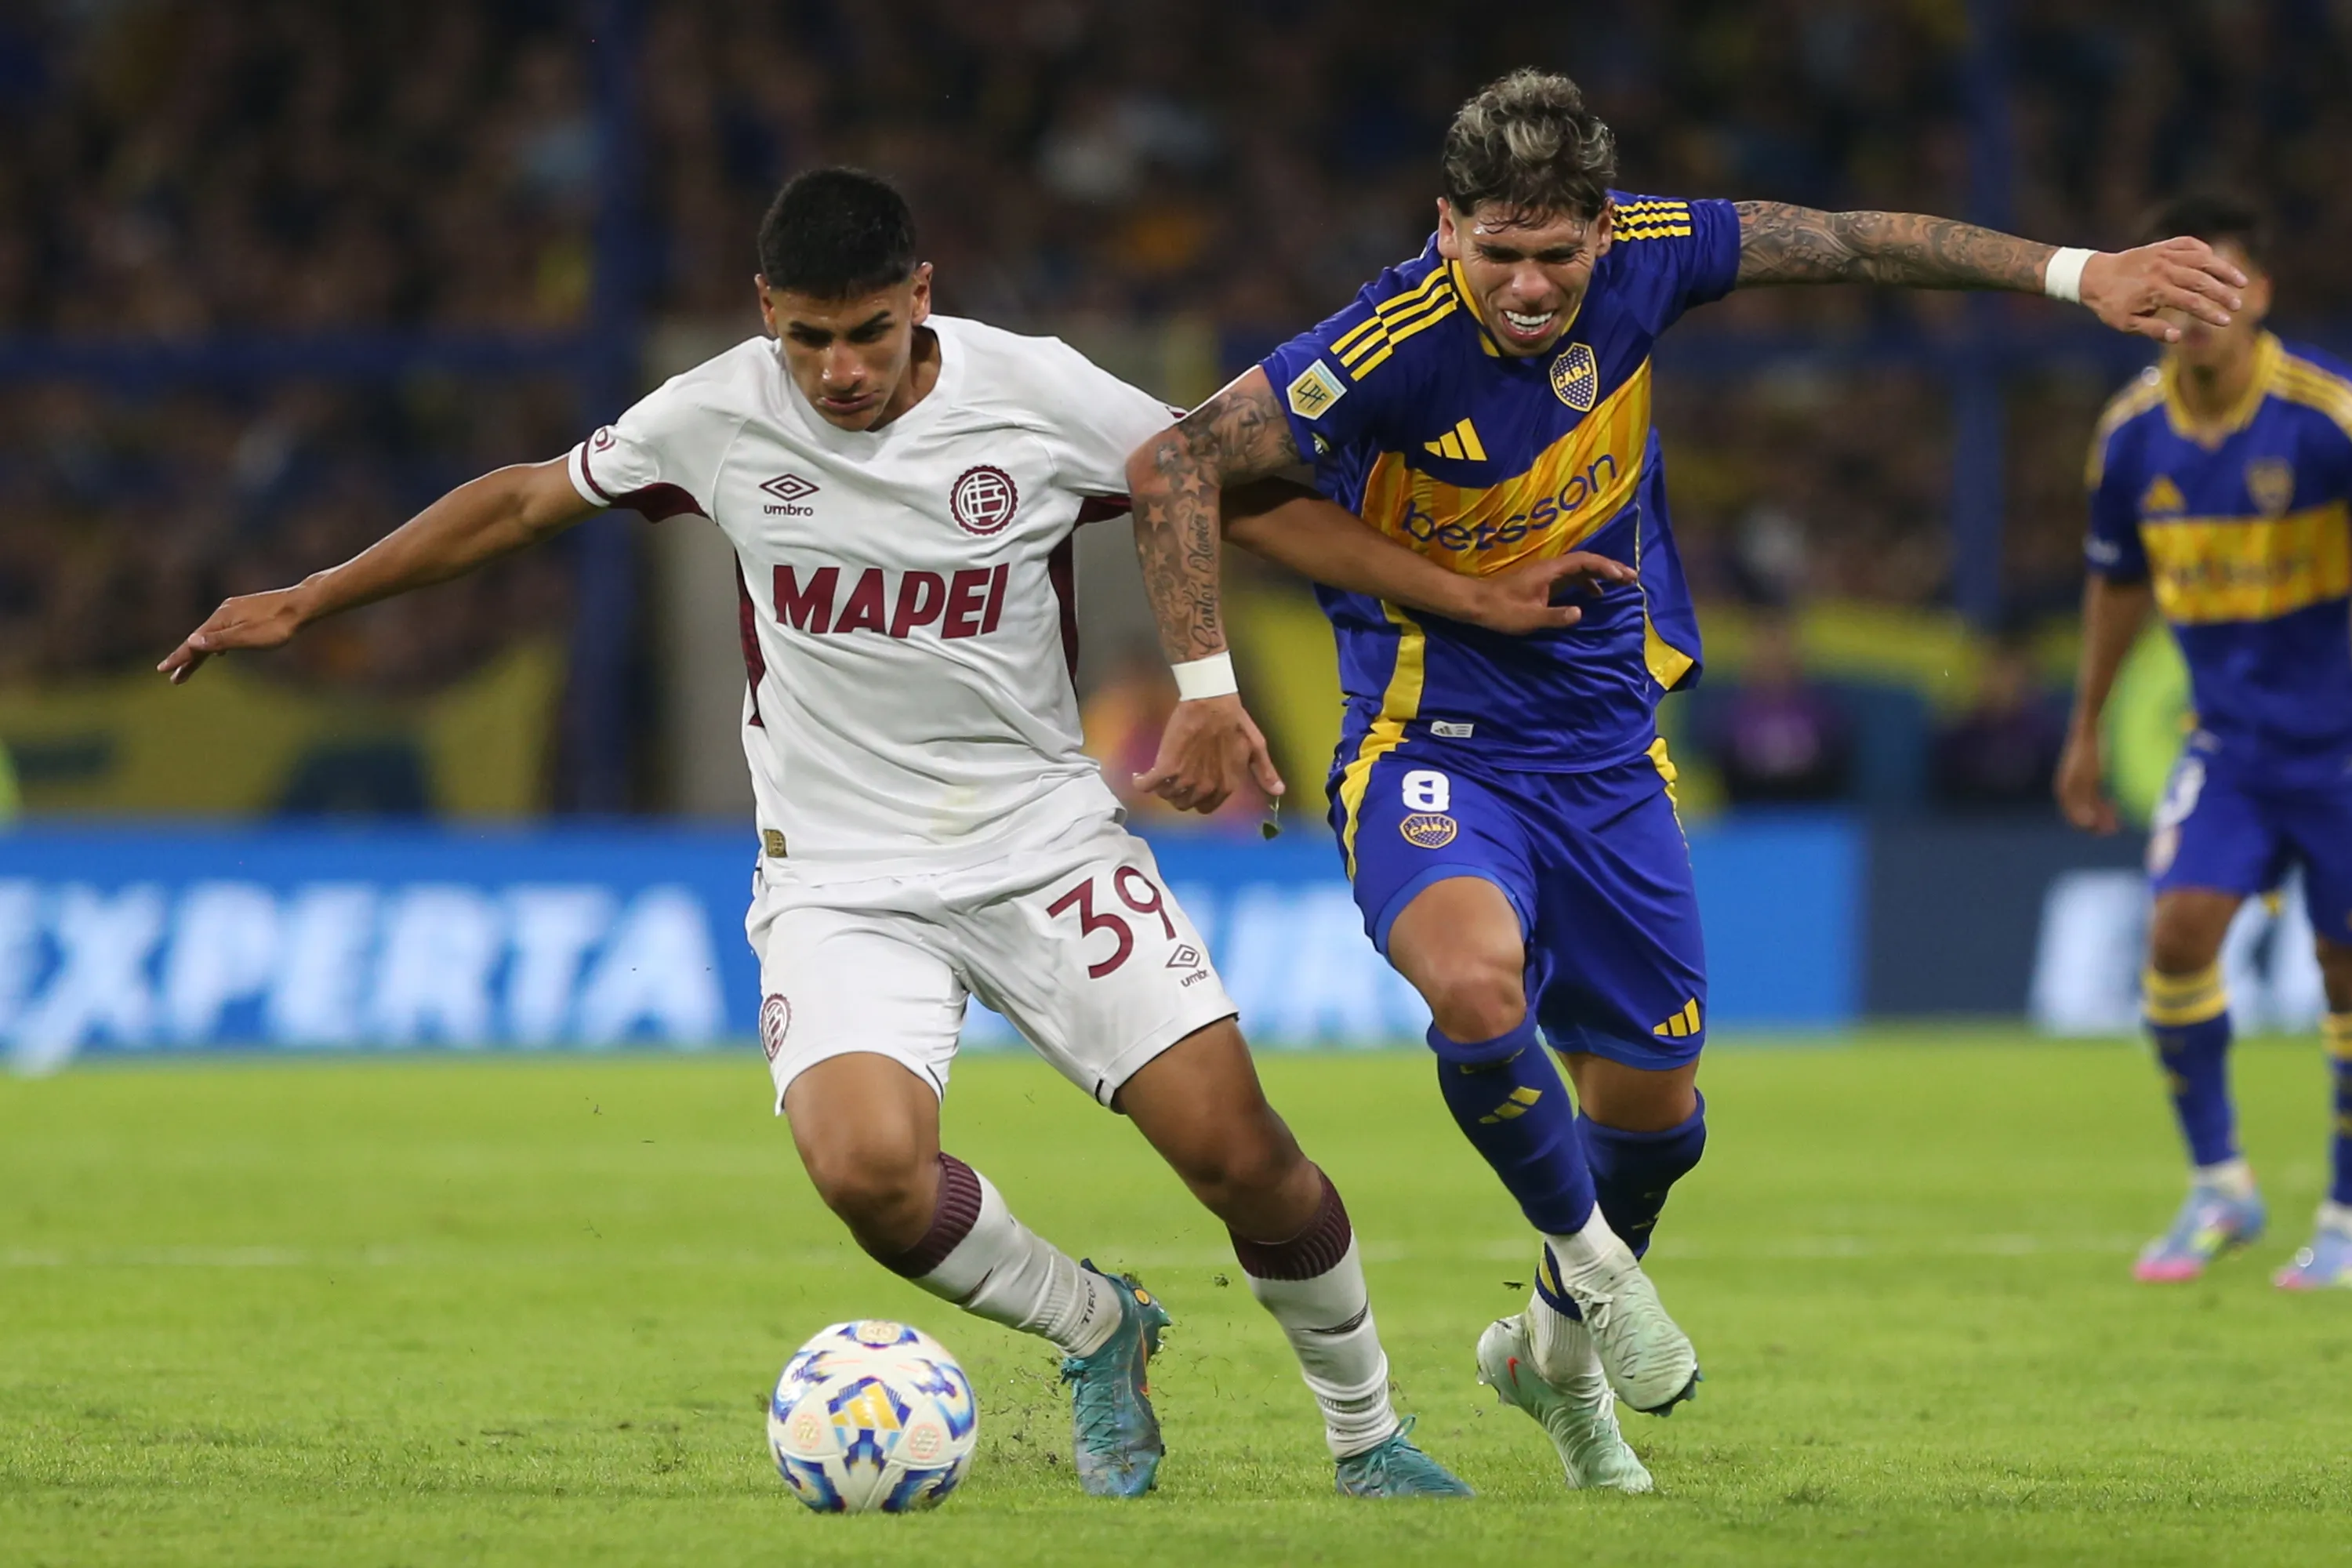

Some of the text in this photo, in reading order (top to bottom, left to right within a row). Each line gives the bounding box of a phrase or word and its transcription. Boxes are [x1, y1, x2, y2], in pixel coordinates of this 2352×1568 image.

[1555, 361, 1591, 389] CABJ
[764, 503, 814, 517] umbro
[1401, 454, 1617, 550] betsson
[773, 562, 1010, 639] MAPEI
[1403, 770, 1449, 811] 8
[1409, 824, 1451, 837] CABJ
[1046, 865, 1177, 979] 39
[1180, 969, 1210, 988] umbr
